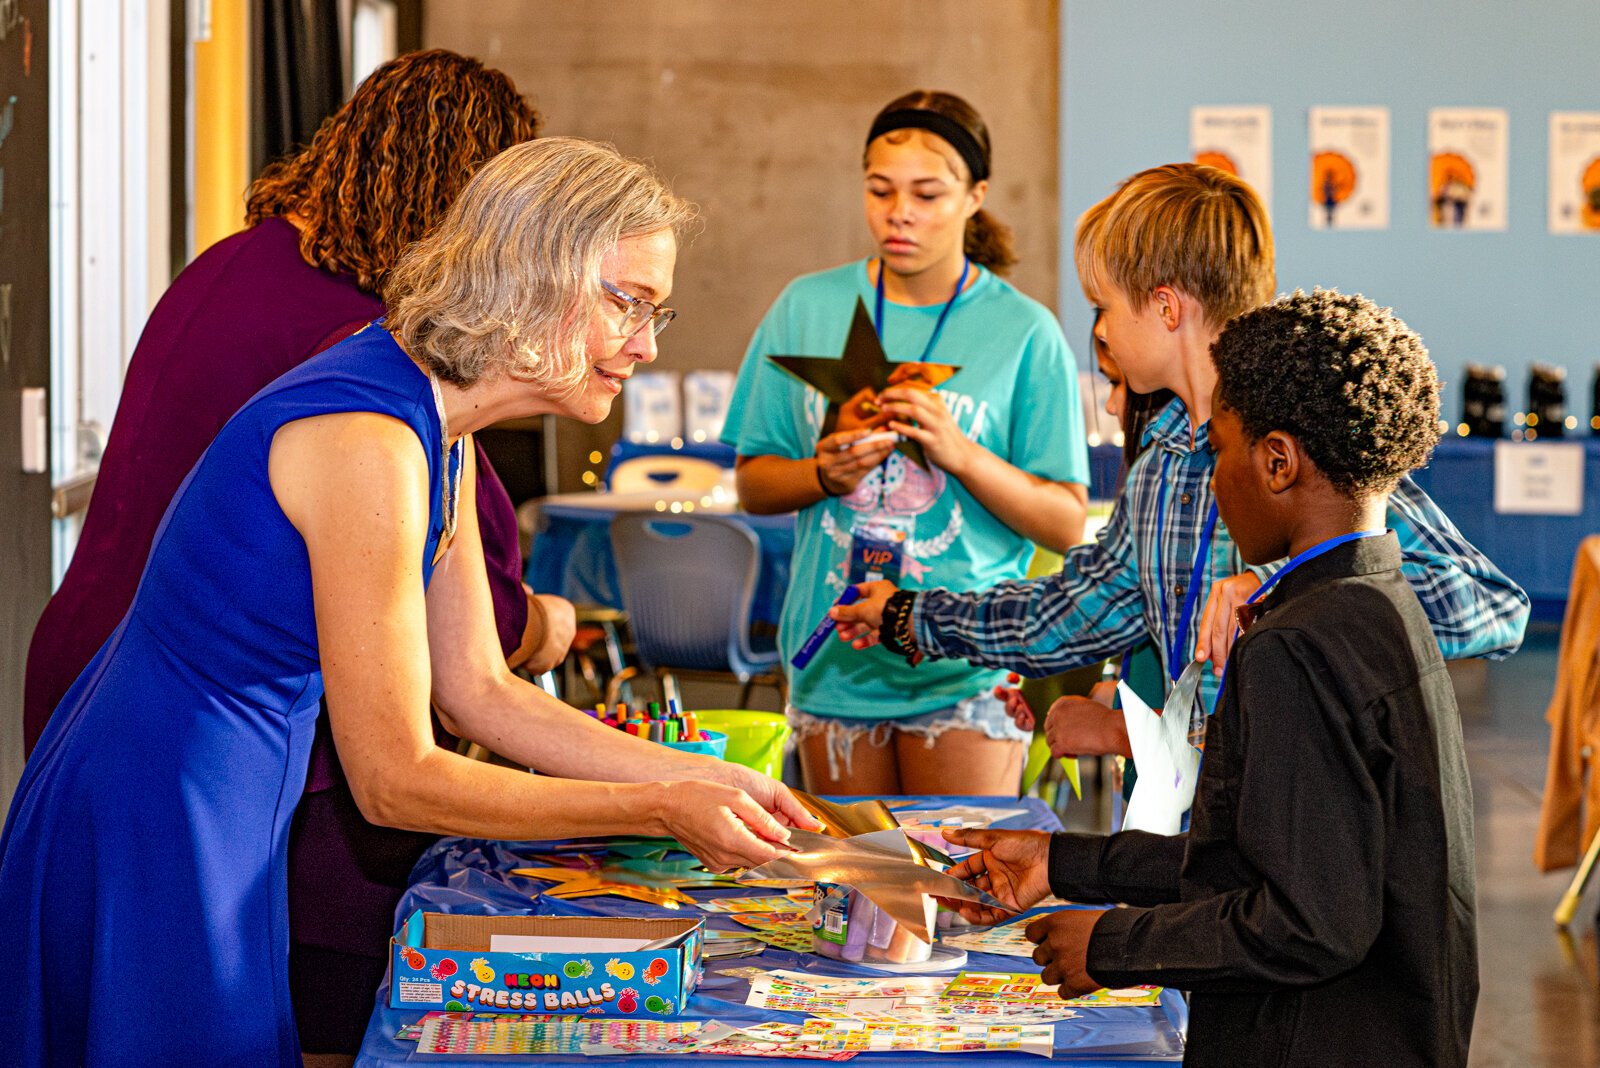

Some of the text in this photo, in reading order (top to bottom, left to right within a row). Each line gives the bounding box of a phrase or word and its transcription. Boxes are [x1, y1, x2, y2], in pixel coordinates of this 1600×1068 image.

[863, 548, 893, 564] VIP
[505, 973, 559, 989] NEON
[450, 980, 537, 1010] STRESS
[544, 983, 616, 1010] BALLS
